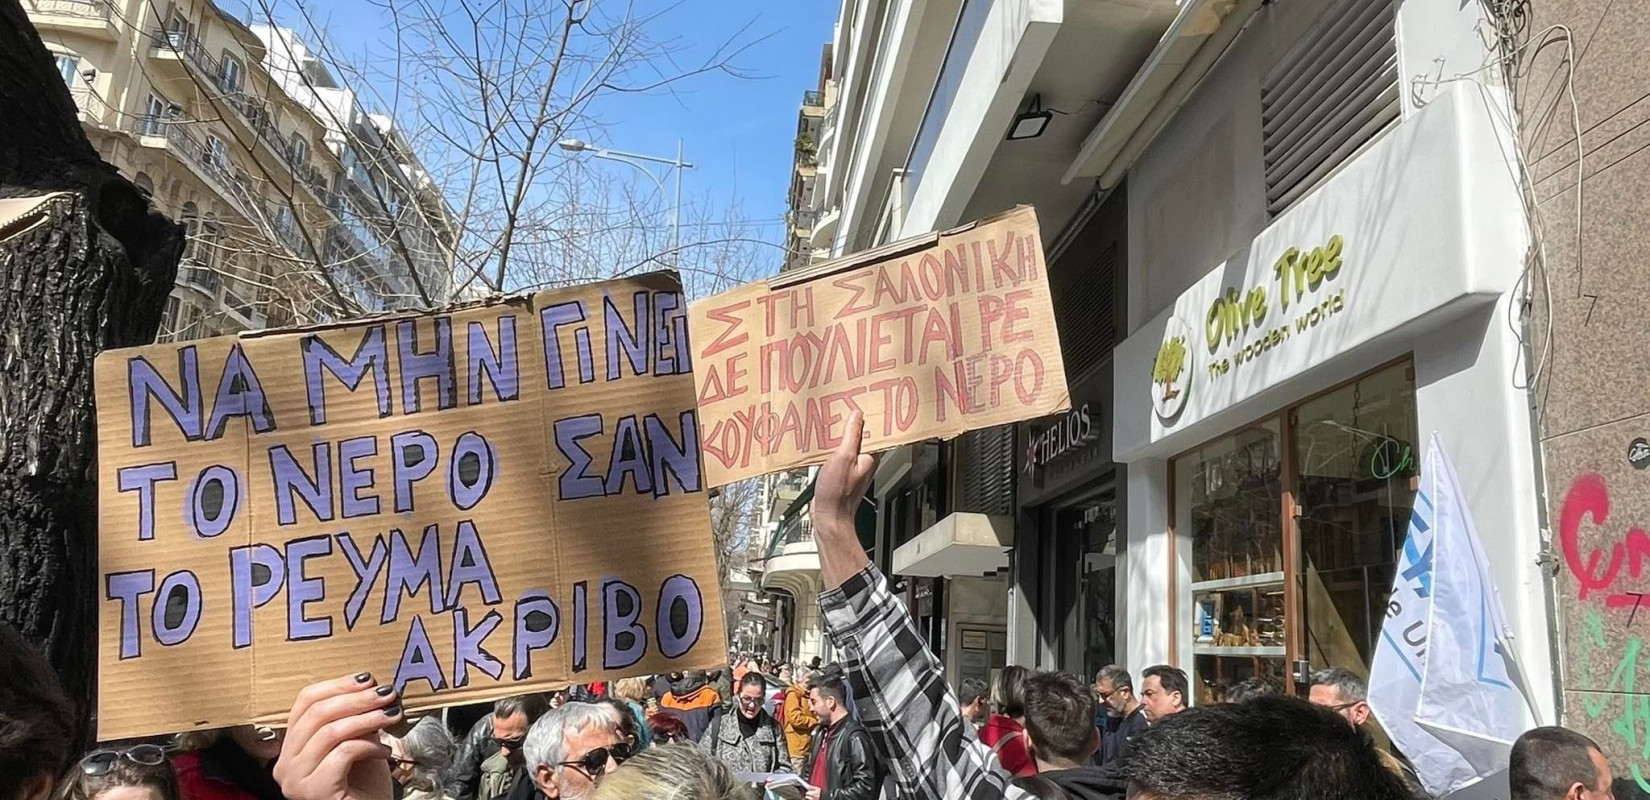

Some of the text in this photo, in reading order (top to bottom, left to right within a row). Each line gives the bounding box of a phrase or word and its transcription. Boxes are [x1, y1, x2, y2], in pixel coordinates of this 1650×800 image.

[698, 289, 1033, 407] ΔΕ ΠΟΥΛΙΕΤΑΙ ΡΕ
[701, 231, 1038, 359] ΣΤΗ ΣΑΛΟΝΙΚΗ
[1205, 234, 1344, 355] Olive Tree
[1208, 288, 1345, 382] The wooden world
[127, 343, 277, 448] ΝΑ
[300, 314, 520, 425] ΜΗΝ
[869, 375, 918, 437] ΤΟ
[935, 348, 1044, 422] ΝΕΡΟ
[1040, 403, 1091, 466] HELIOS
[117, 409, 703, 540] ΤΟ ΝΕΡΟ ΣΑΝ
[105, 520, 502, 660] ΤΟ ΡΕΥΜΑ
[394, 574, 703, 697] ΑΚΡΙΒΟ
